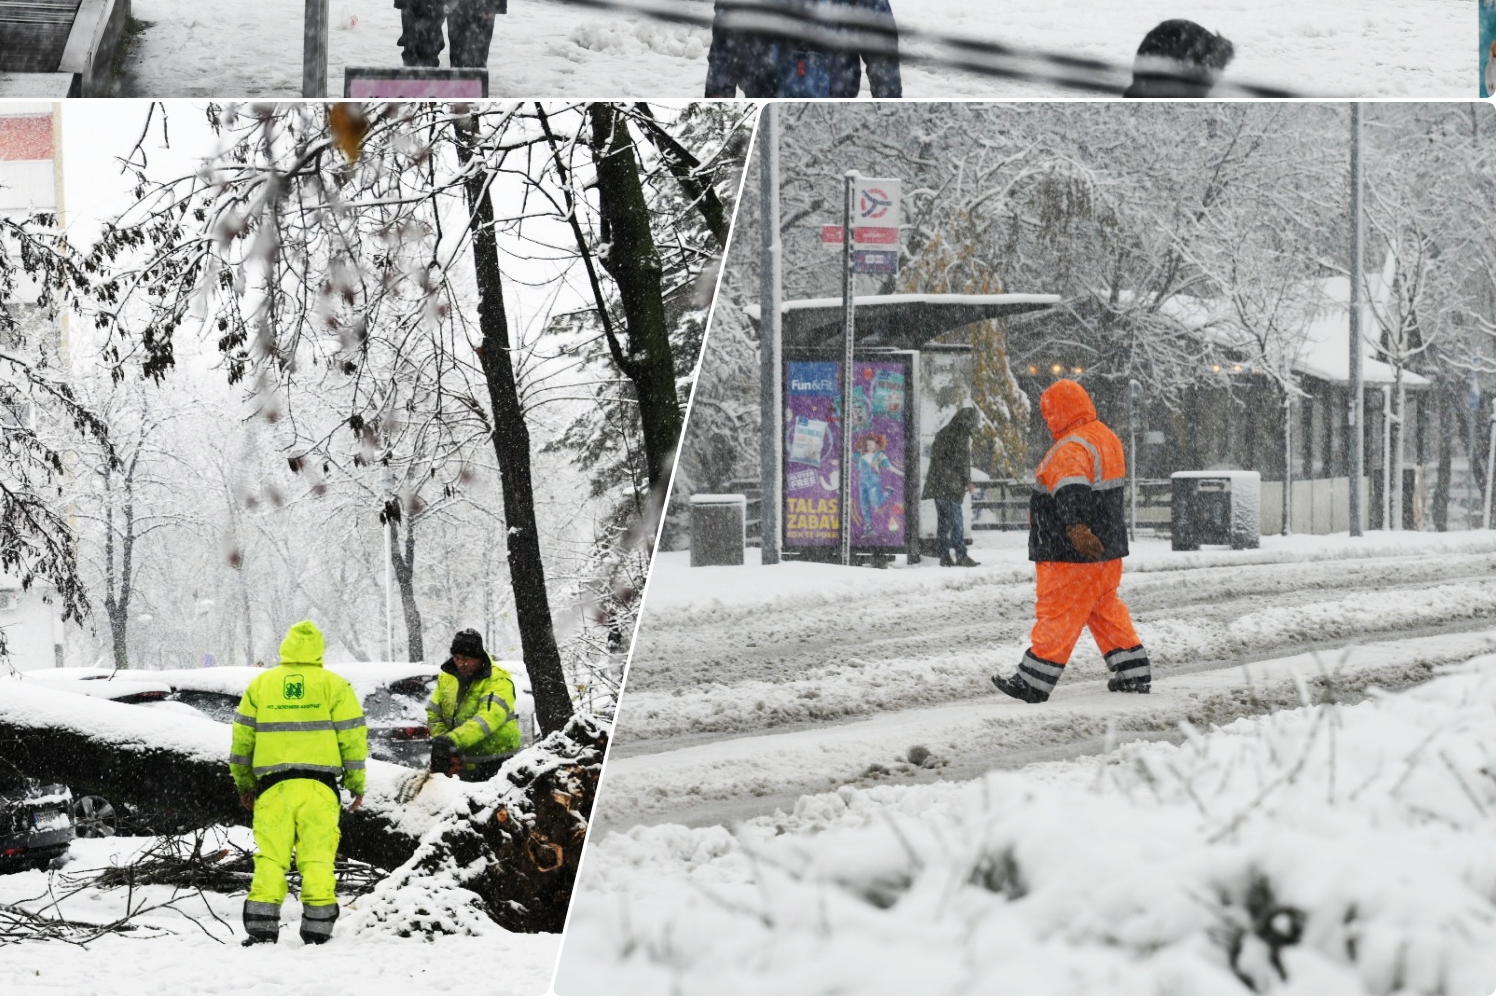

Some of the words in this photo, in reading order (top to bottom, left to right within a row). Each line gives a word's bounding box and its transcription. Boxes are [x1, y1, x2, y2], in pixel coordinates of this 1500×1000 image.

[792, 380, 833, 390] Fun&Fit
[791, 477, 816, 488] FREE
[788, 498, 838, 513] TALAS
[788, 514, 839, 529] ZABAV
